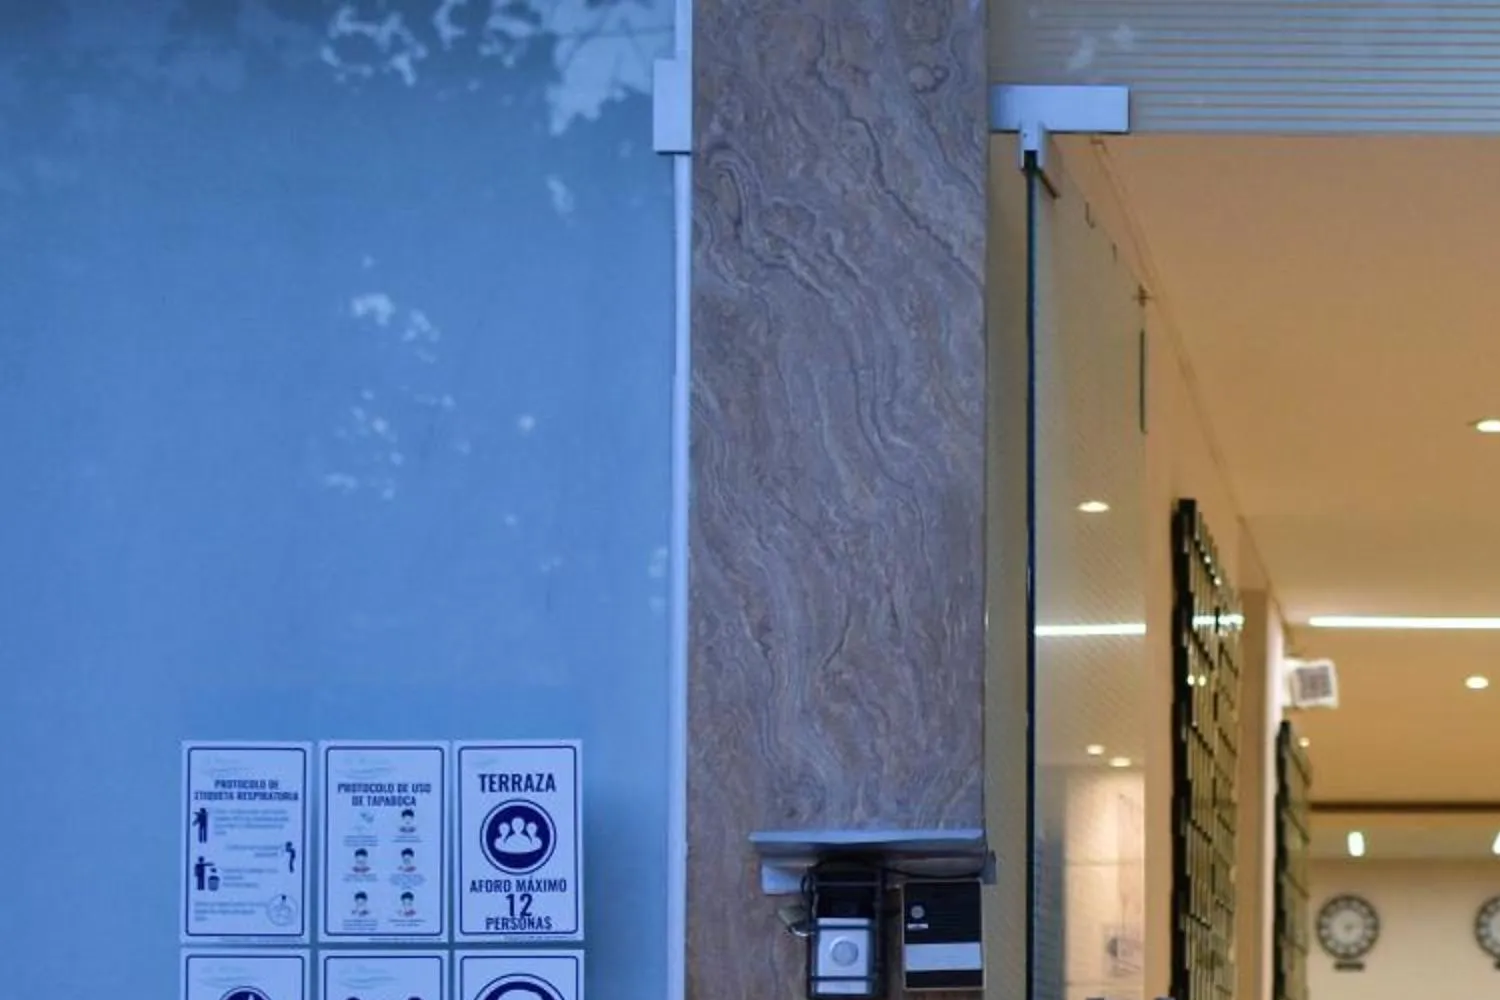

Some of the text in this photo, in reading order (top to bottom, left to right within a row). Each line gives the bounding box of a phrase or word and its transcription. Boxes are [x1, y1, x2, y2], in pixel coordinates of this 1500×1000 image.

[337, 783, 432, 793] PROTOCOLO DE USO
[478, 773, 556, 793] TERRAZA
[351, 795, 417, 806] DE TAPABOCA
[469, 875, 567, 893] AFORO MÁXIMO
[505, 893, 533, 917] 12
[485, 916, 553, 931] PERSONAS
